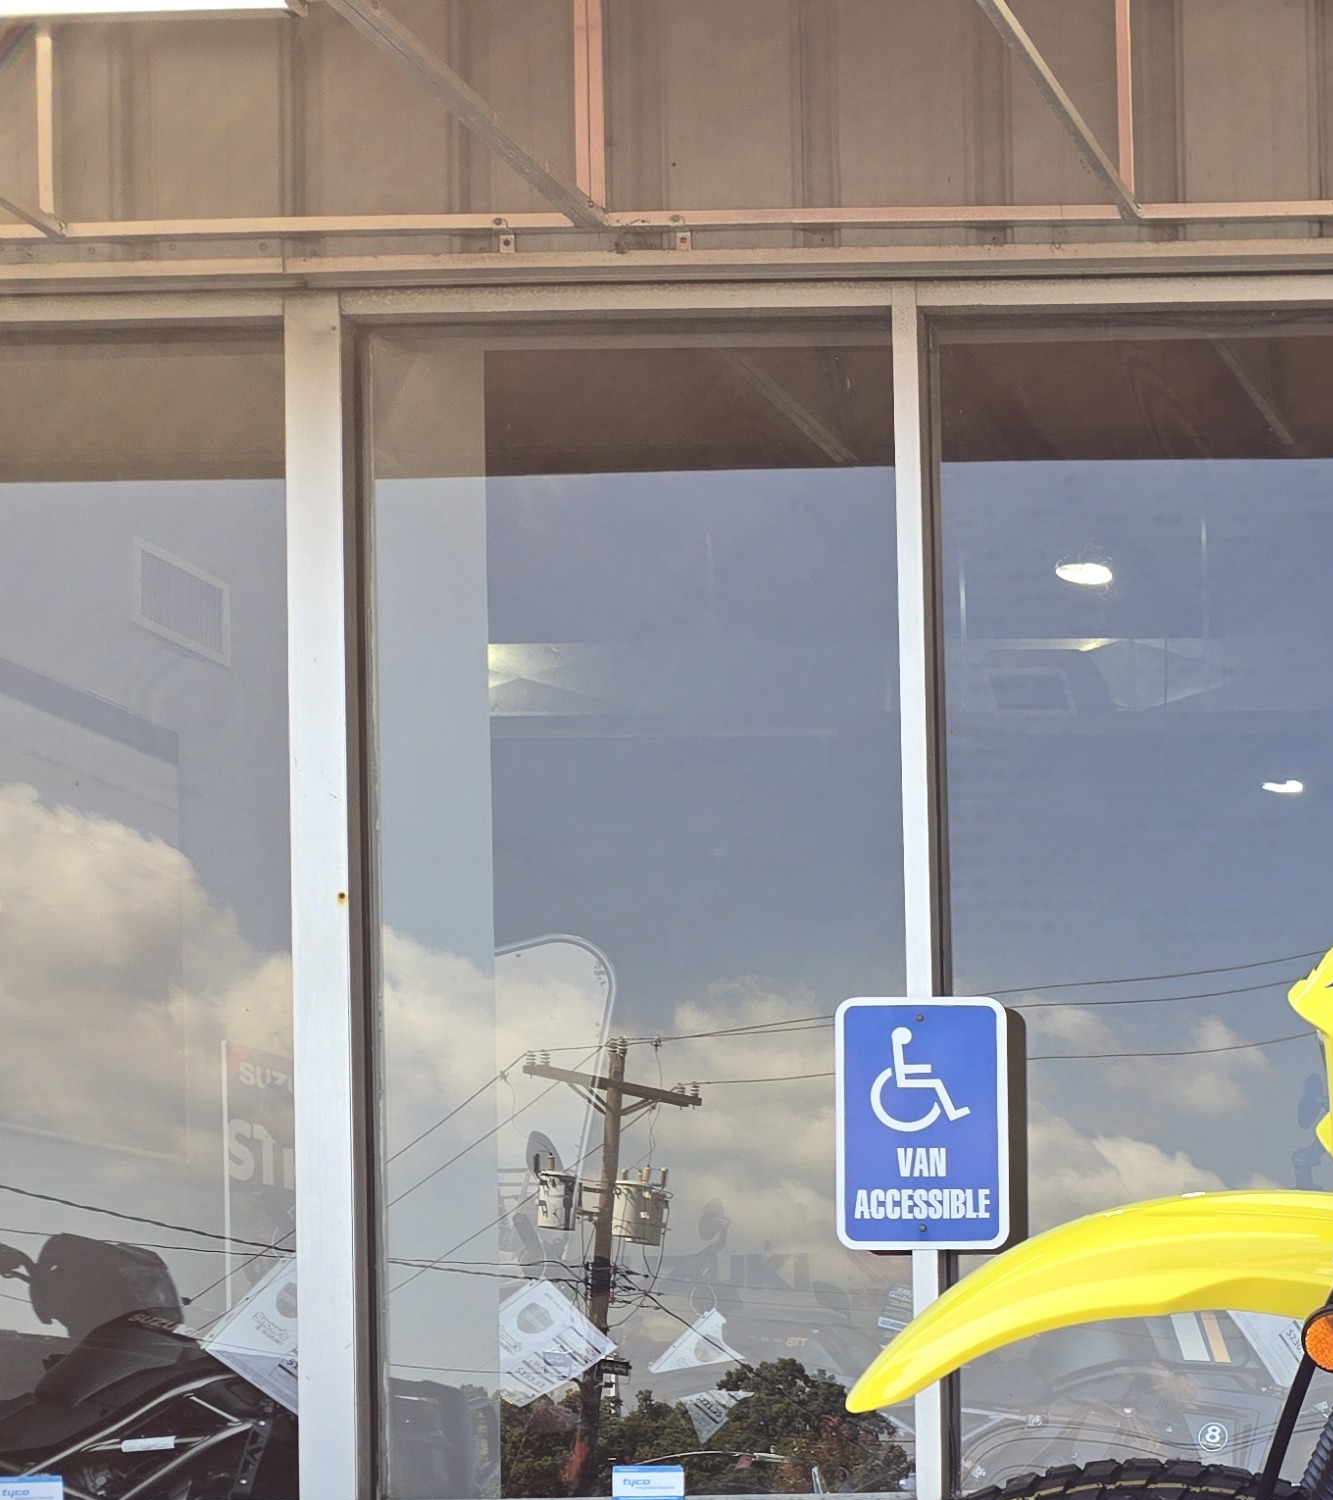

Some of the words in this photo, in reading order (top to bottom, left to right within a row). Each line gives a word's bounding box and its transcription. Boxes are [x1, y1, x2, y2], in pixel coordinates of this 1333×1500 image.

[896, 1147, 946, 1177] VAN
[854, 1188, 990, 1220] ACCESSIBLE
[127, 1312, 181, 1333] SUZU
[1205, 1425, 1221, 1443] 8
[623, 1478, 650, 1487] tyco
[2, 1489, 30, 1498] tyco
